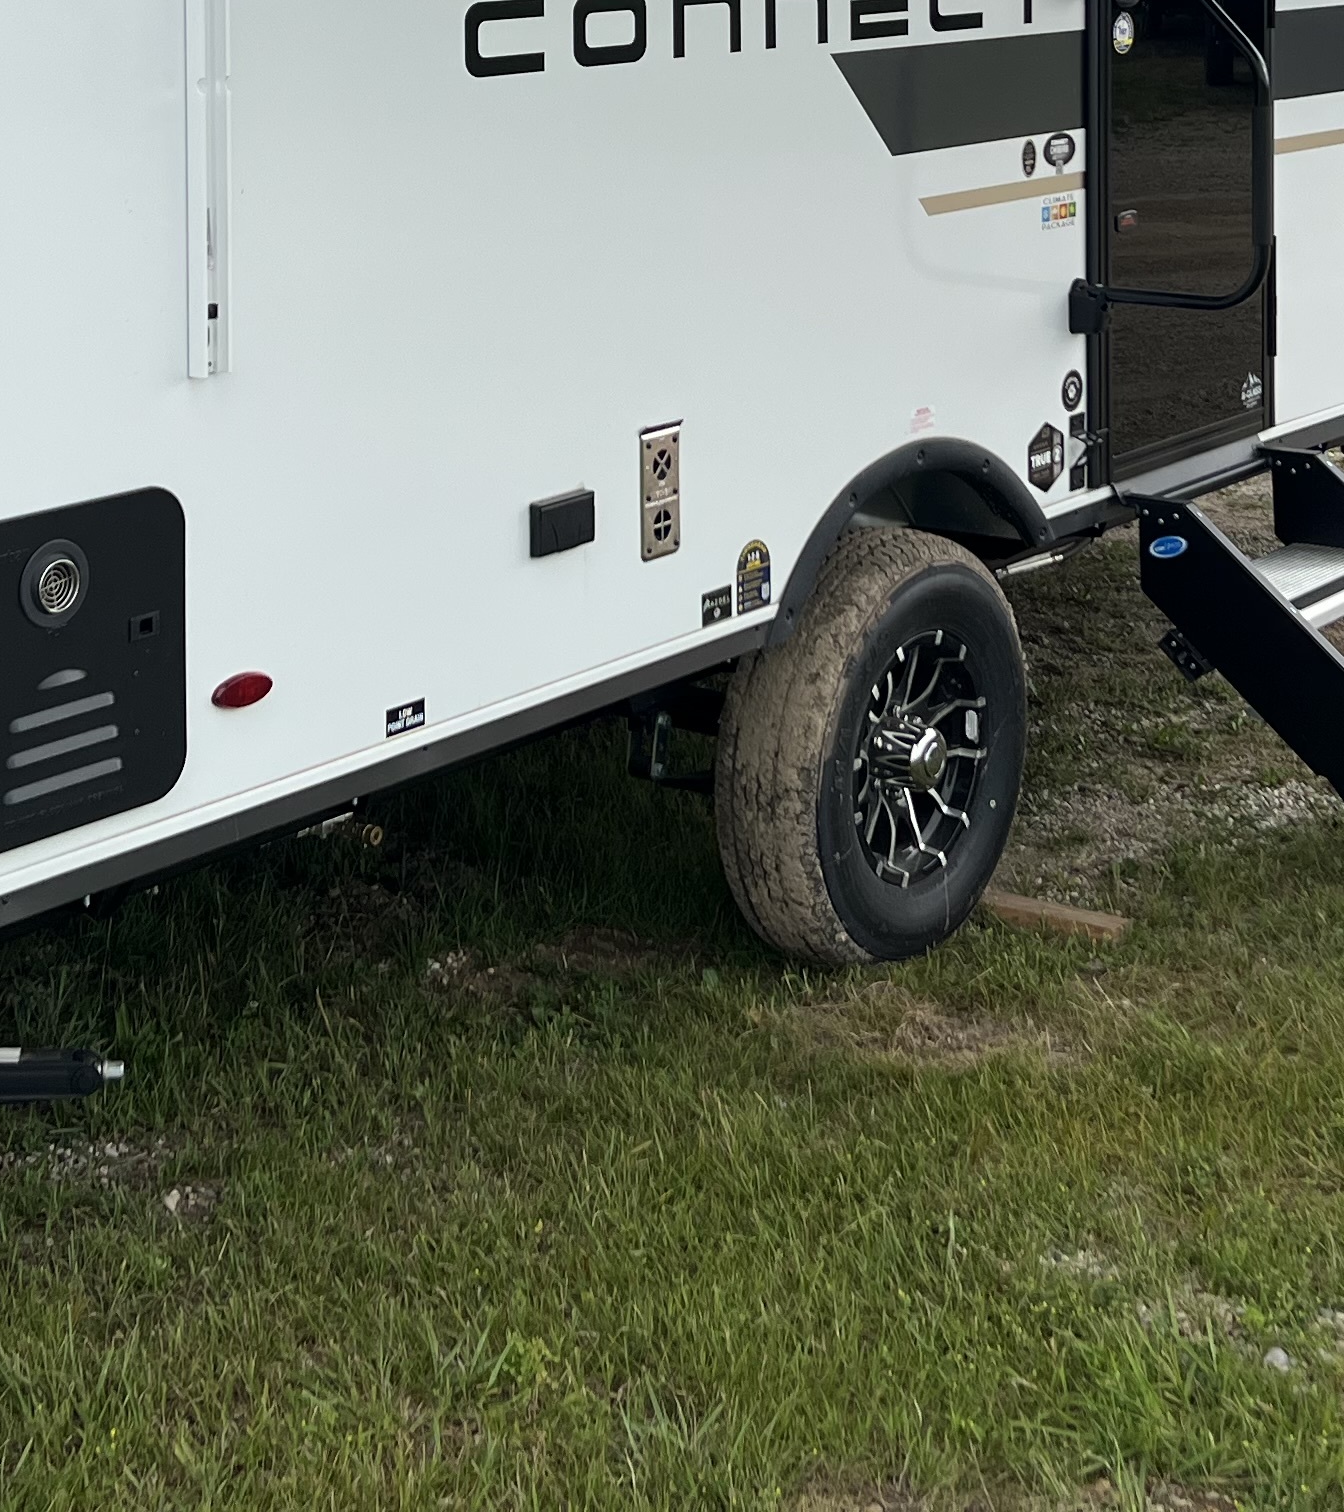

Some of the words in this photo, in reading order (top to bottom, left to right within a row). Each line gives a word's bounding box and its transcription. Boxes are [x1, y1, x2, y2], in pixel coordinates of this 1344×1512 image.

[1042, 193, 1074, 205] CLIMATE
[1041, 219, 1075, 231] PACKAGE
[398, 706, 413, 719] LOW
